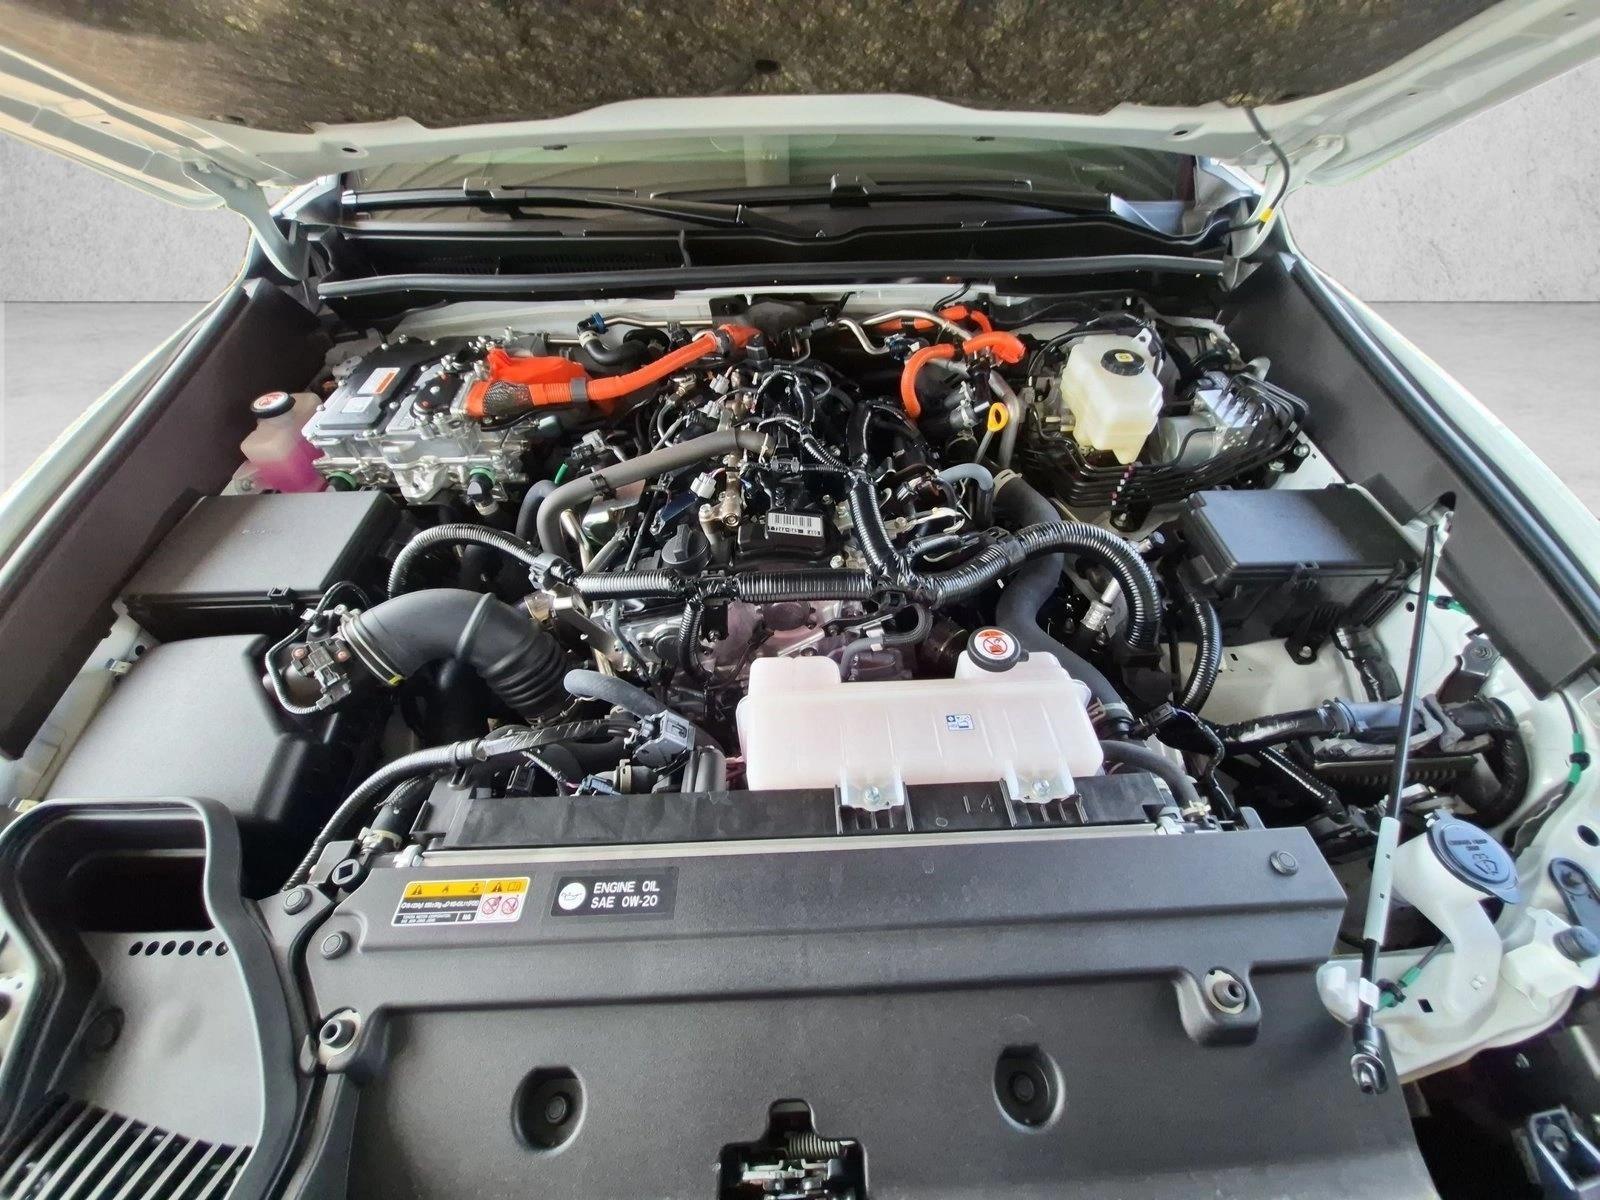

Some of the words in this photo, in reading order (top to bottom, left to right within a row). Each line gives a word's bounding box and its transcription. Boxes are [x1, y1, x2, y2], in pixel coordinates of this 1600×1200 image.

[593, 881, 636, 894] ENGINE
[642, 880, 661, 892] OIL
[590, 896, 616, 909] SAE
[621, 895, 659, 908] 0W-20
